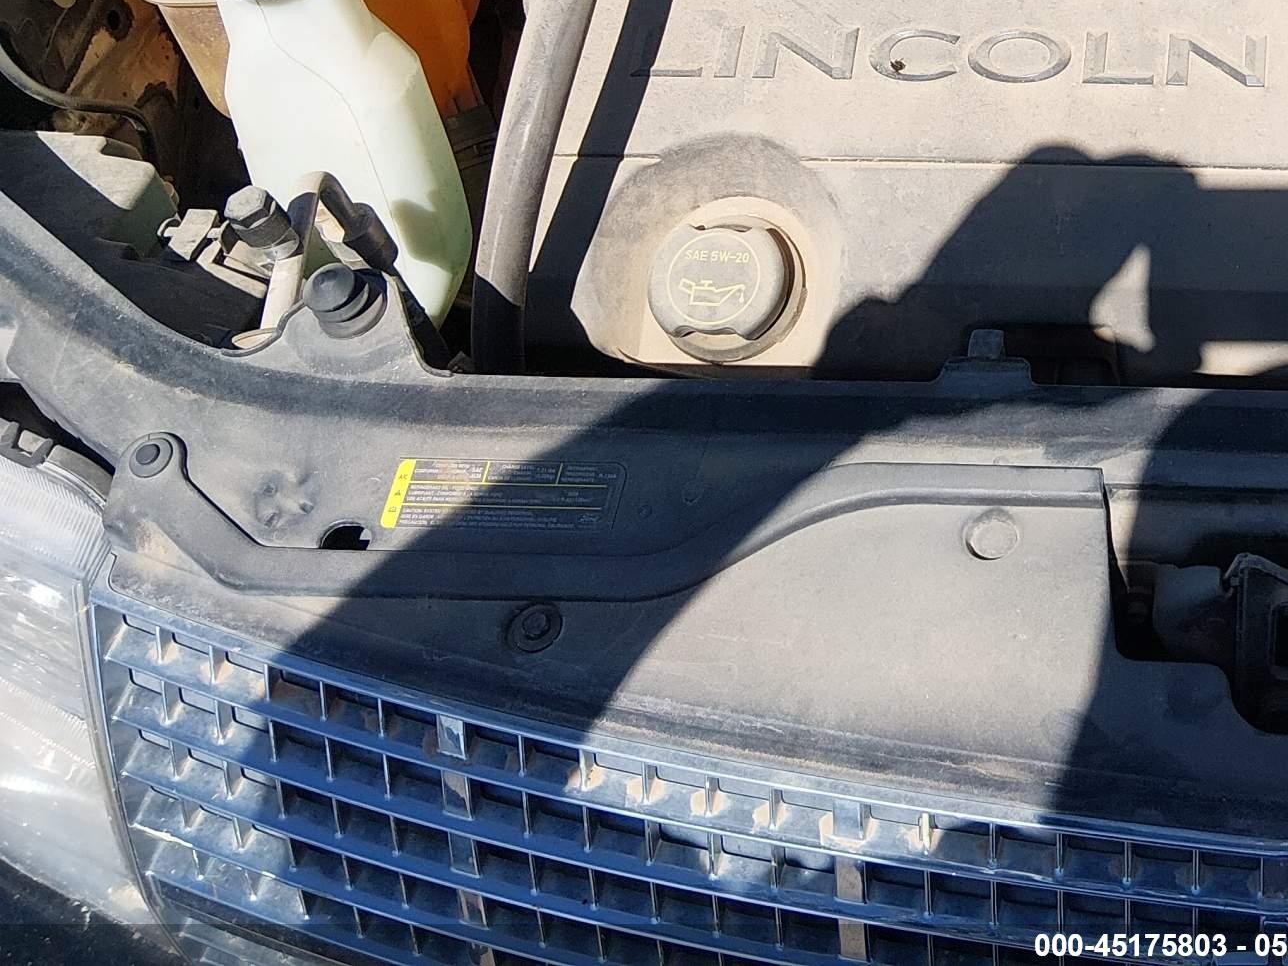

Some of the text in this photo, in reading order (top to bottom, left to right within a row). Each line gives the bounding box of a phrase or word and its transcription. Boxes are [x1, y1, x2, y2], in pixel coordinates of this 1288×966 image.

[630, 24, 1266, 88] LINCOLN
[685, 250, 749, 263] SAE 5W-20
